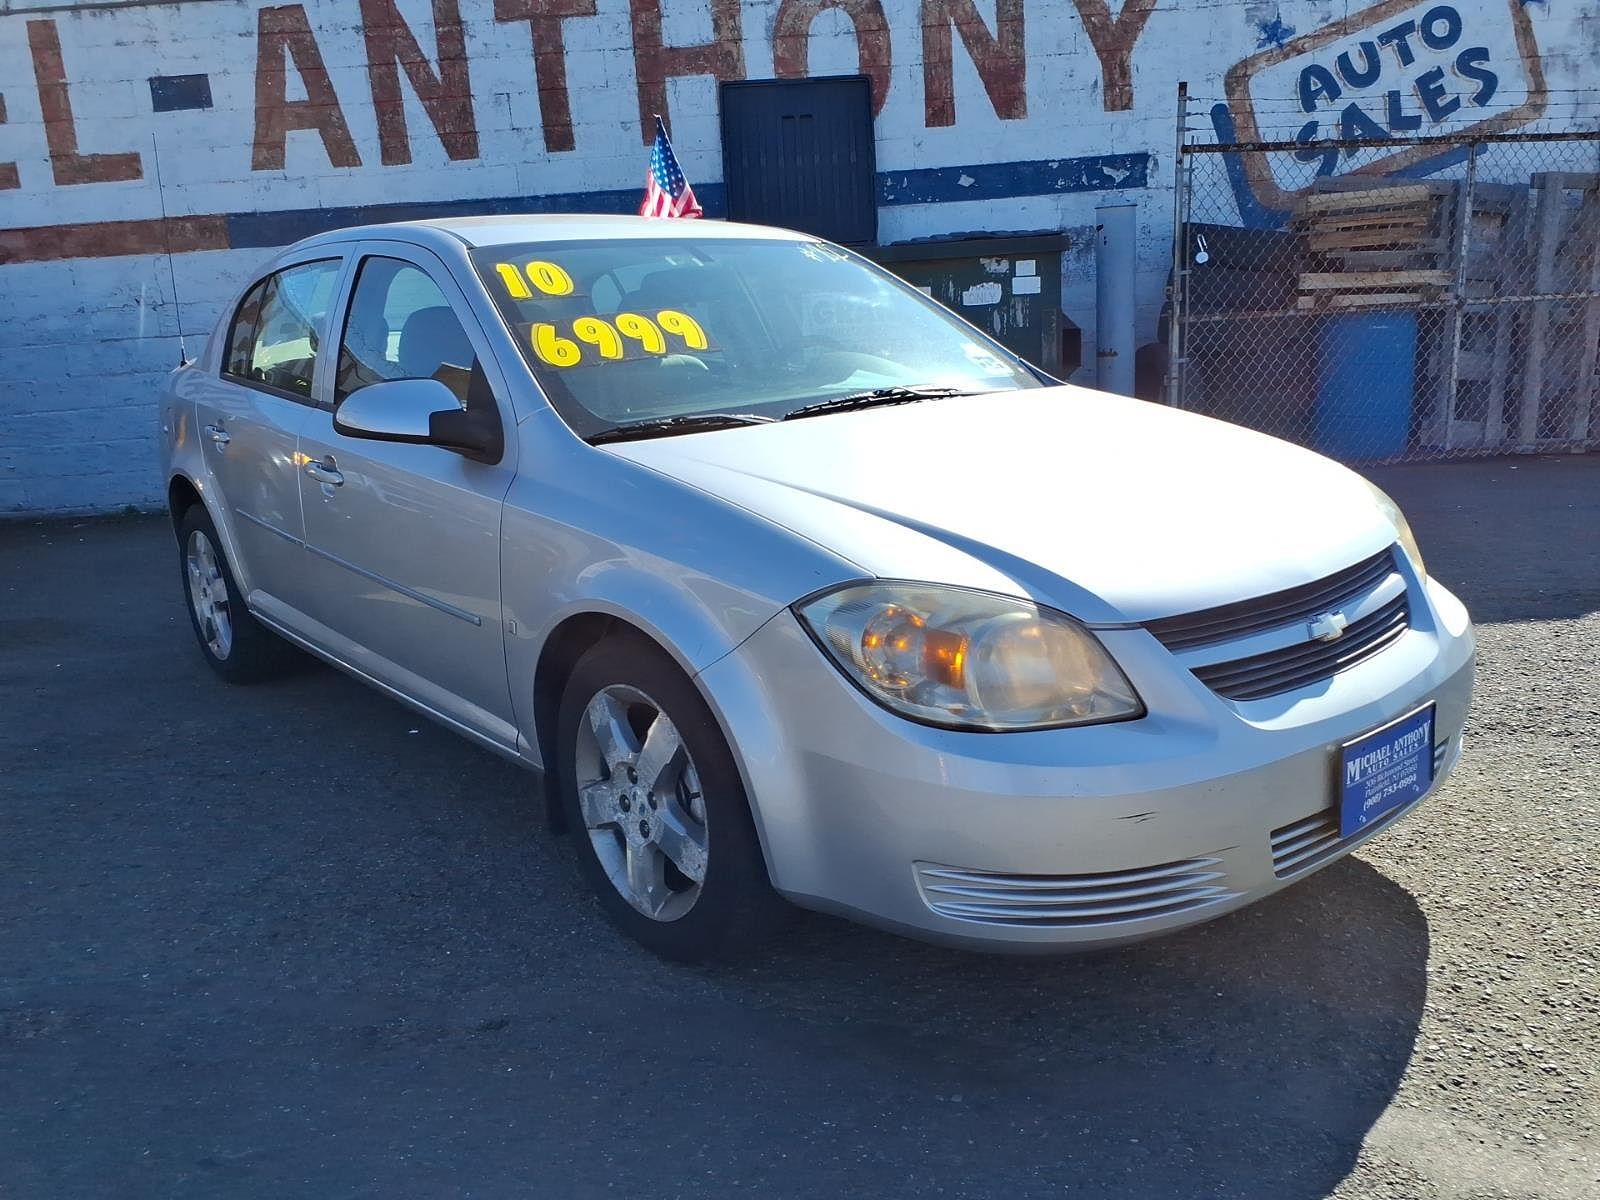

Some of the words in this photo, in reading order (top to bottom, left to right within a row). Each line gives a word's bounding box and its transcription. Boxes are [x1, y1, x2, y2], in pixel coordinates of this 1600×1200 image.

[251, 0, 1157, 171] ANTHONY
[1298, 5, 1462, 113] AUTO
[1294, 46, 1498, 177] SALES
[495, 260, 575, 298] 10
[531, 310, 708, 367] 6999
[1347, 744, 1391, 784] MICHAEL
[1393, 719, 1431, 753] ANTHONY
[1366, 758, 1389, 775] AUTO
[1393, 742, 1419, 760] SALES
